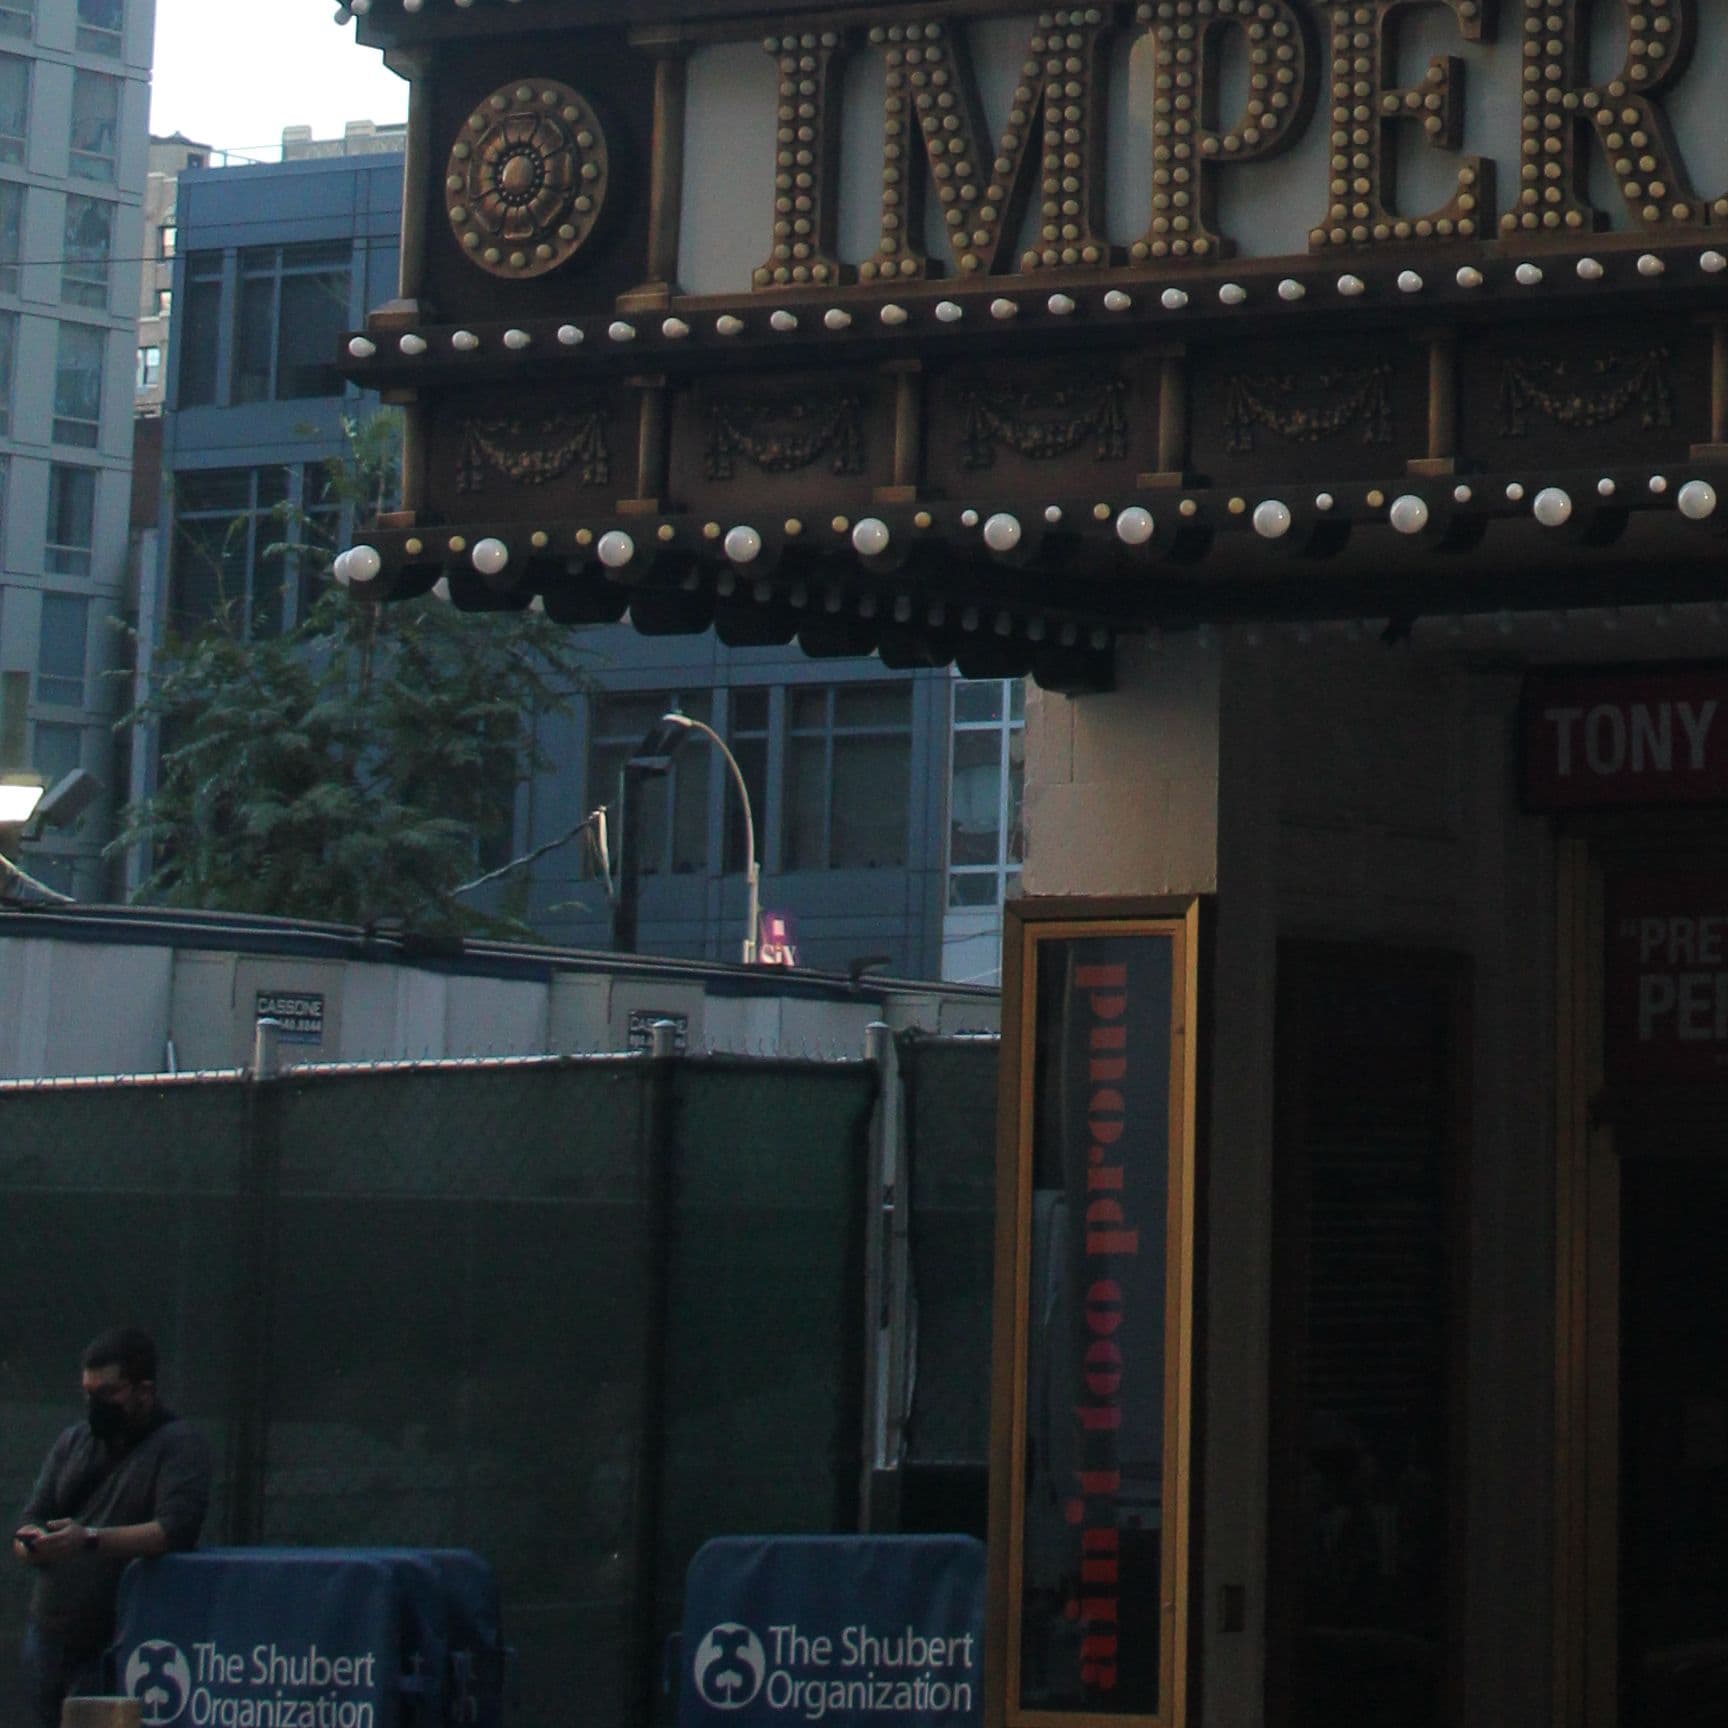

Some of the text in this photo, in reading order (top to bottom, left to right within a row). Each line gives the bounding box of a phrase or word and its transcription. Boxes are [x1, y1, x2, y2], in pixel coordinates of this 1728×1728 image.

[1545, 699, 1719, 777] TONY
[258, 997, 322, 1017] CASSONE
[1073, 963, 1139, 1255] proud
[1073, 1279, 1123, 1431] too
[193, 1642, 376, 1688] The Shubert
[767, 1623, 975, 1669] The Shubert
[191, 1687, 375, 1728] Organization
[766, 1670, 973, 1721] Organization
